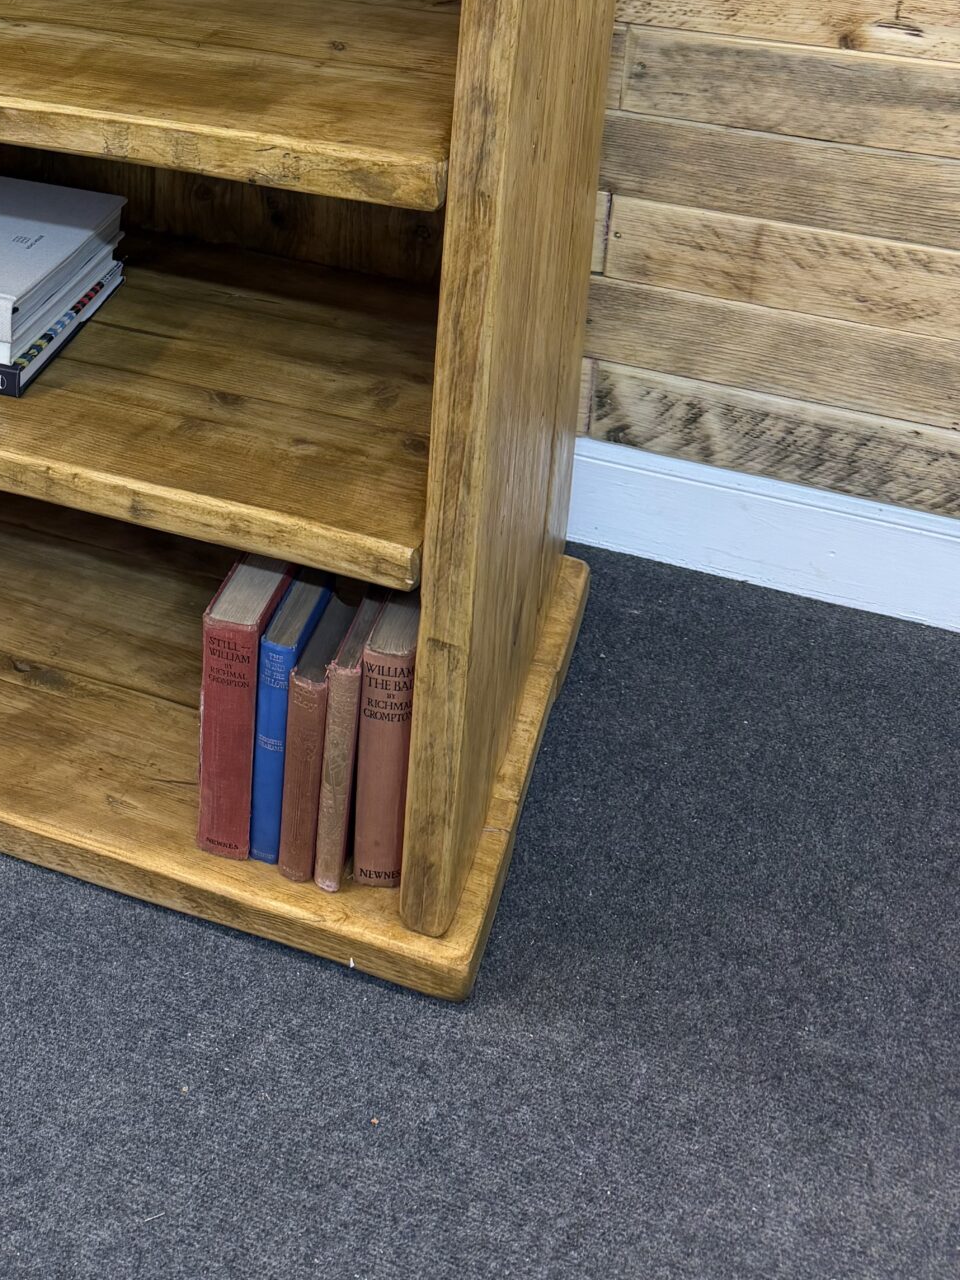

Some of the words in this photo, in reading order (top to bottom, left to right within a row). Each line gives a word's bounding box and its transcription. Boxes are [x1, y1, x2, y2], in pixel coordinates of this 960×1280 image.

[209, 647, 250, 664] WILLIAM
[208, 673, 249, 688] CROMPTON
[210, 666, 247, 680] RICHMAL
[365, 675, 391, 691] THE
[206, 836, 239, 850] NEWNES
